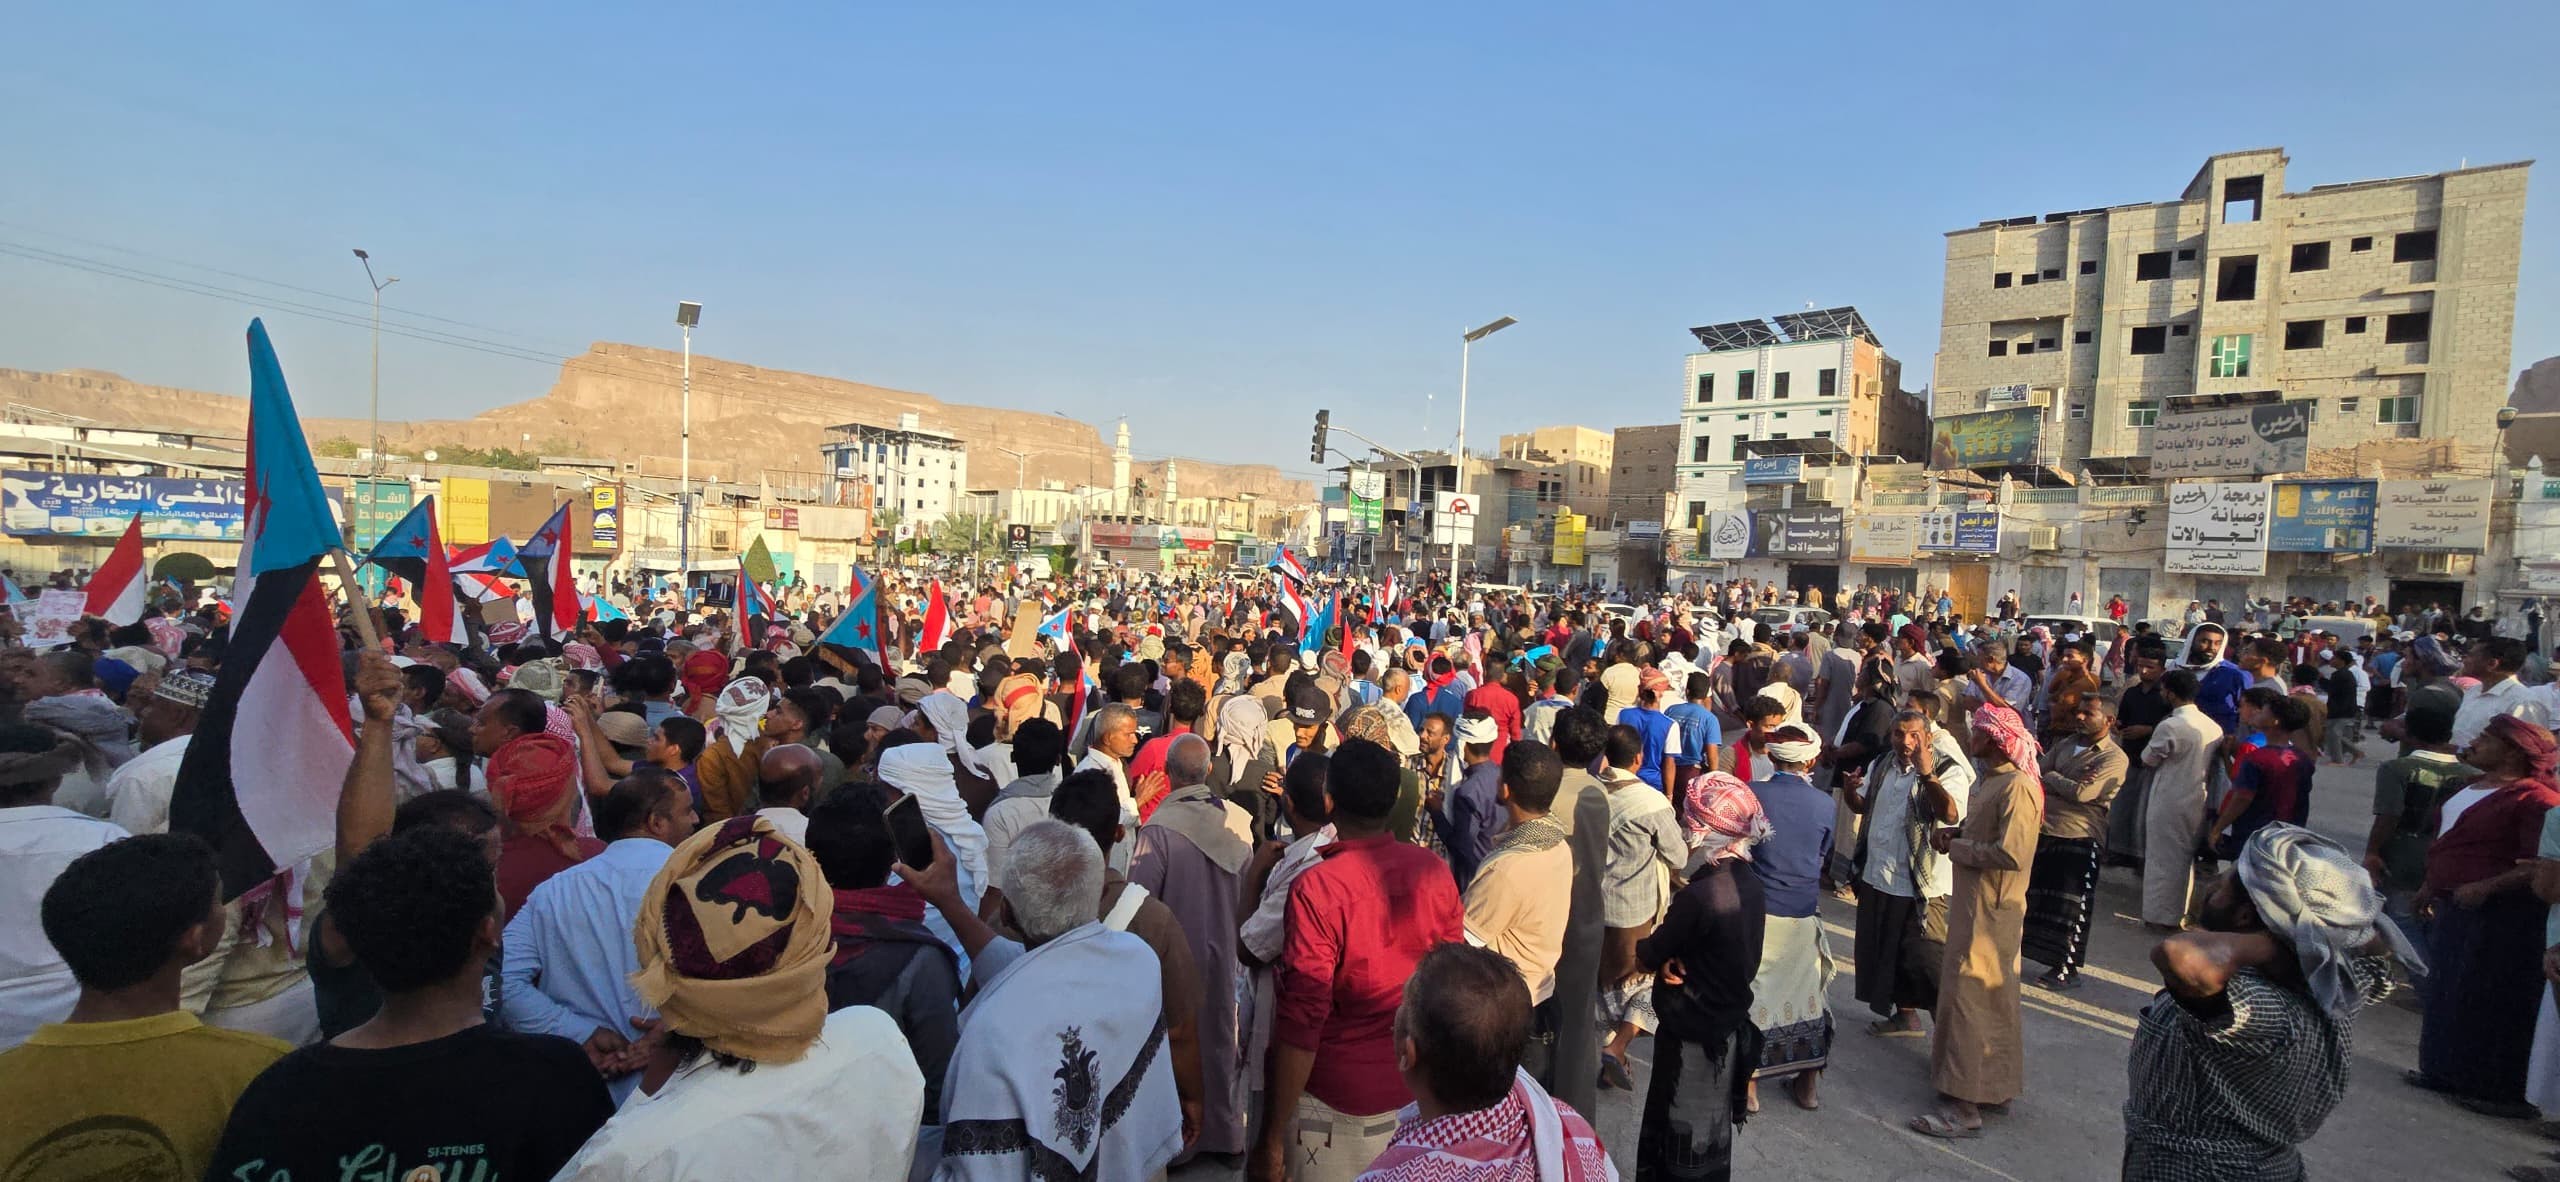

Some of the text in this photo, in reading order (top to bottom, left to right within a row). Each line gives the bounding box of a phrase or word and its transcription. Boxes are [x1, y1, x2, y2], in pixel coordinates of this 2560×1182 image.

[2202, 414, 2248, 429] لصيانة
[2207, 434, 2250, 449] الجوالات
[2153, 455, 2249, 472] وبيع قطع غيارها
[51, 476, 151, 504] التجارية
[2223, 486, 2265, 506] برمجة
[2337, 487, 2369, 501] عالم
[2391, 494, 2480, 505] ملك الصيانة
[2211, 506, 2265, 526] وصيانة
[2305, 502, 2369, 518] الجوالات
[2171, 526, 2263, 546] الجوالات
[2384, 536, 2442, 546] الجوالات
[1787, 542, 1839, 554] الجوالات
[2188, 549, 2242, 561] الحرمين
[427, 1144, 485, 1158] SI-TENES
